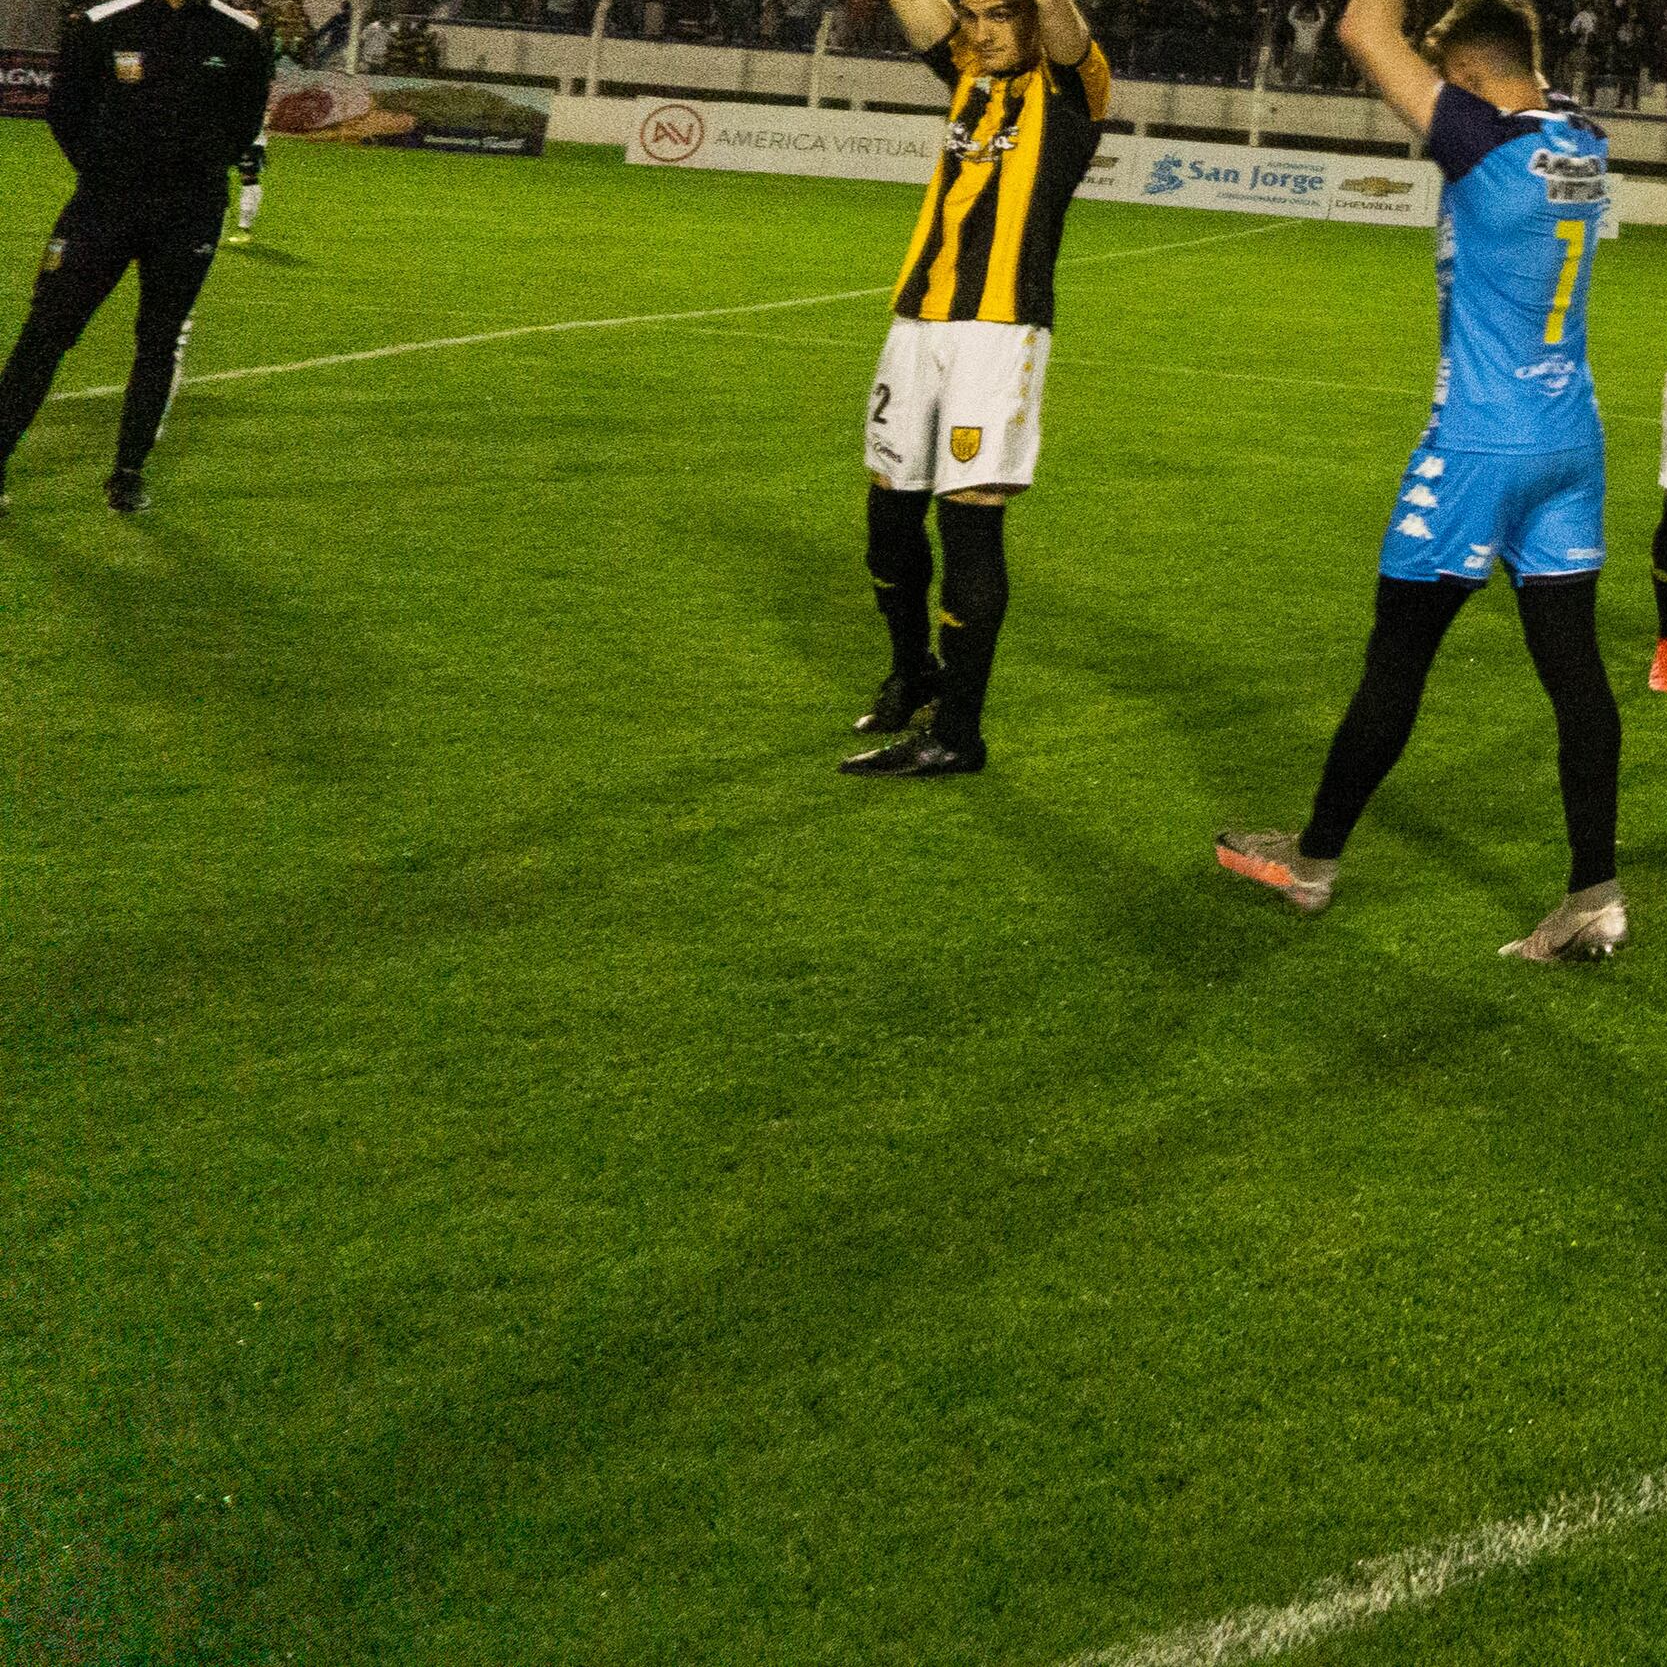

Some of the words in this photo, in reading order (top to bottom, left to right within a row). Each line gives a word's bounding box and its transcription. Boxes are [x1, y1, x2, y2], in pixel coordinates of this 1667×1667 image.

[714, 129, 827, 152] AMERICA
[834, 135, 932, 158] VIRTUAL
[1189, 159, 1240, 184] San
[1250, 165, 1324, 195] Jorge
[872, 383, 891, 424] 2
